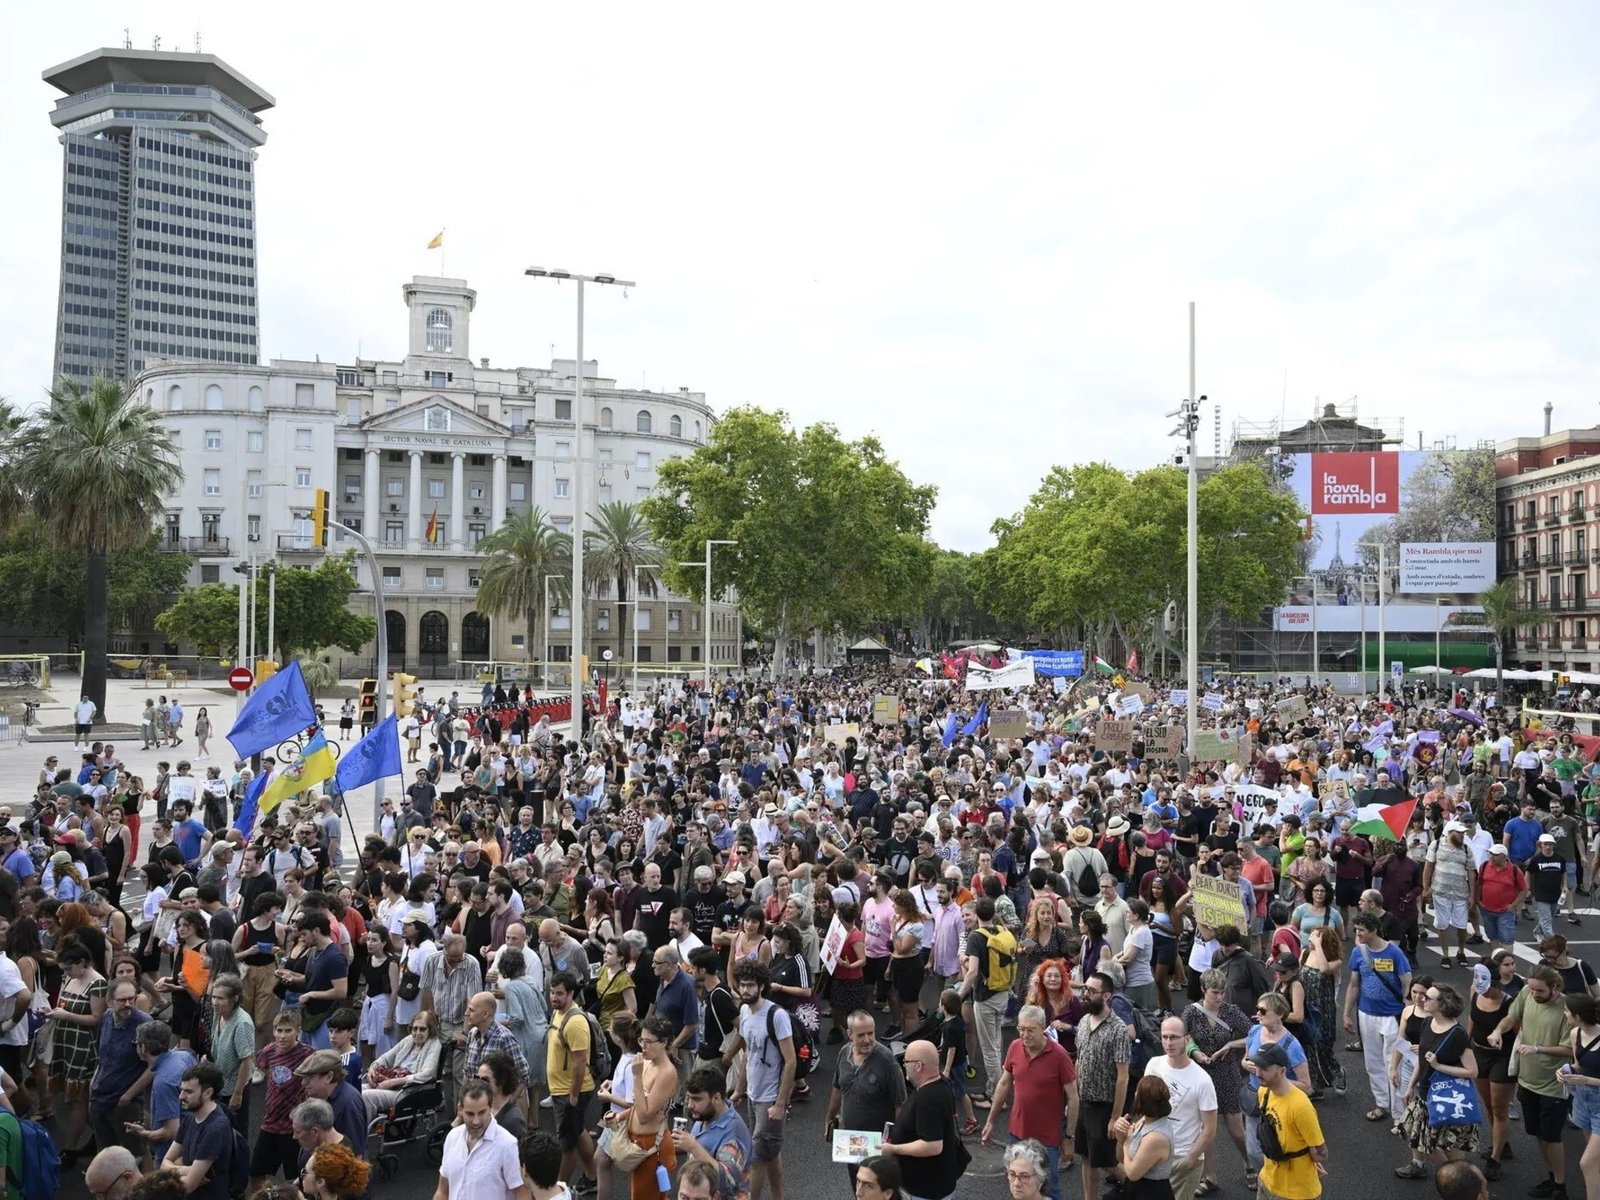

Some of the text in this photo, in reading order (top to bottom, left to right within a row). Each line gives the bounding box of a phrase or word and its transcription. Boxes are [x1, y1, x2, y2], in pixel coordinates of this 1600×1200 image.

[384, 435, 411, 443] SECTOR
[415, 437, 437, 445] NAVAL
[1324, 472, 1336, 484] la
[1324, 484, 1359, 493] nova
[1406, 547, 1421, 555] Més
[1146, 727, 1153, 738] EL
[1196, 875, 1241, 900] DEAR TOURIST
[1201, 907, 1215, 925] IS
